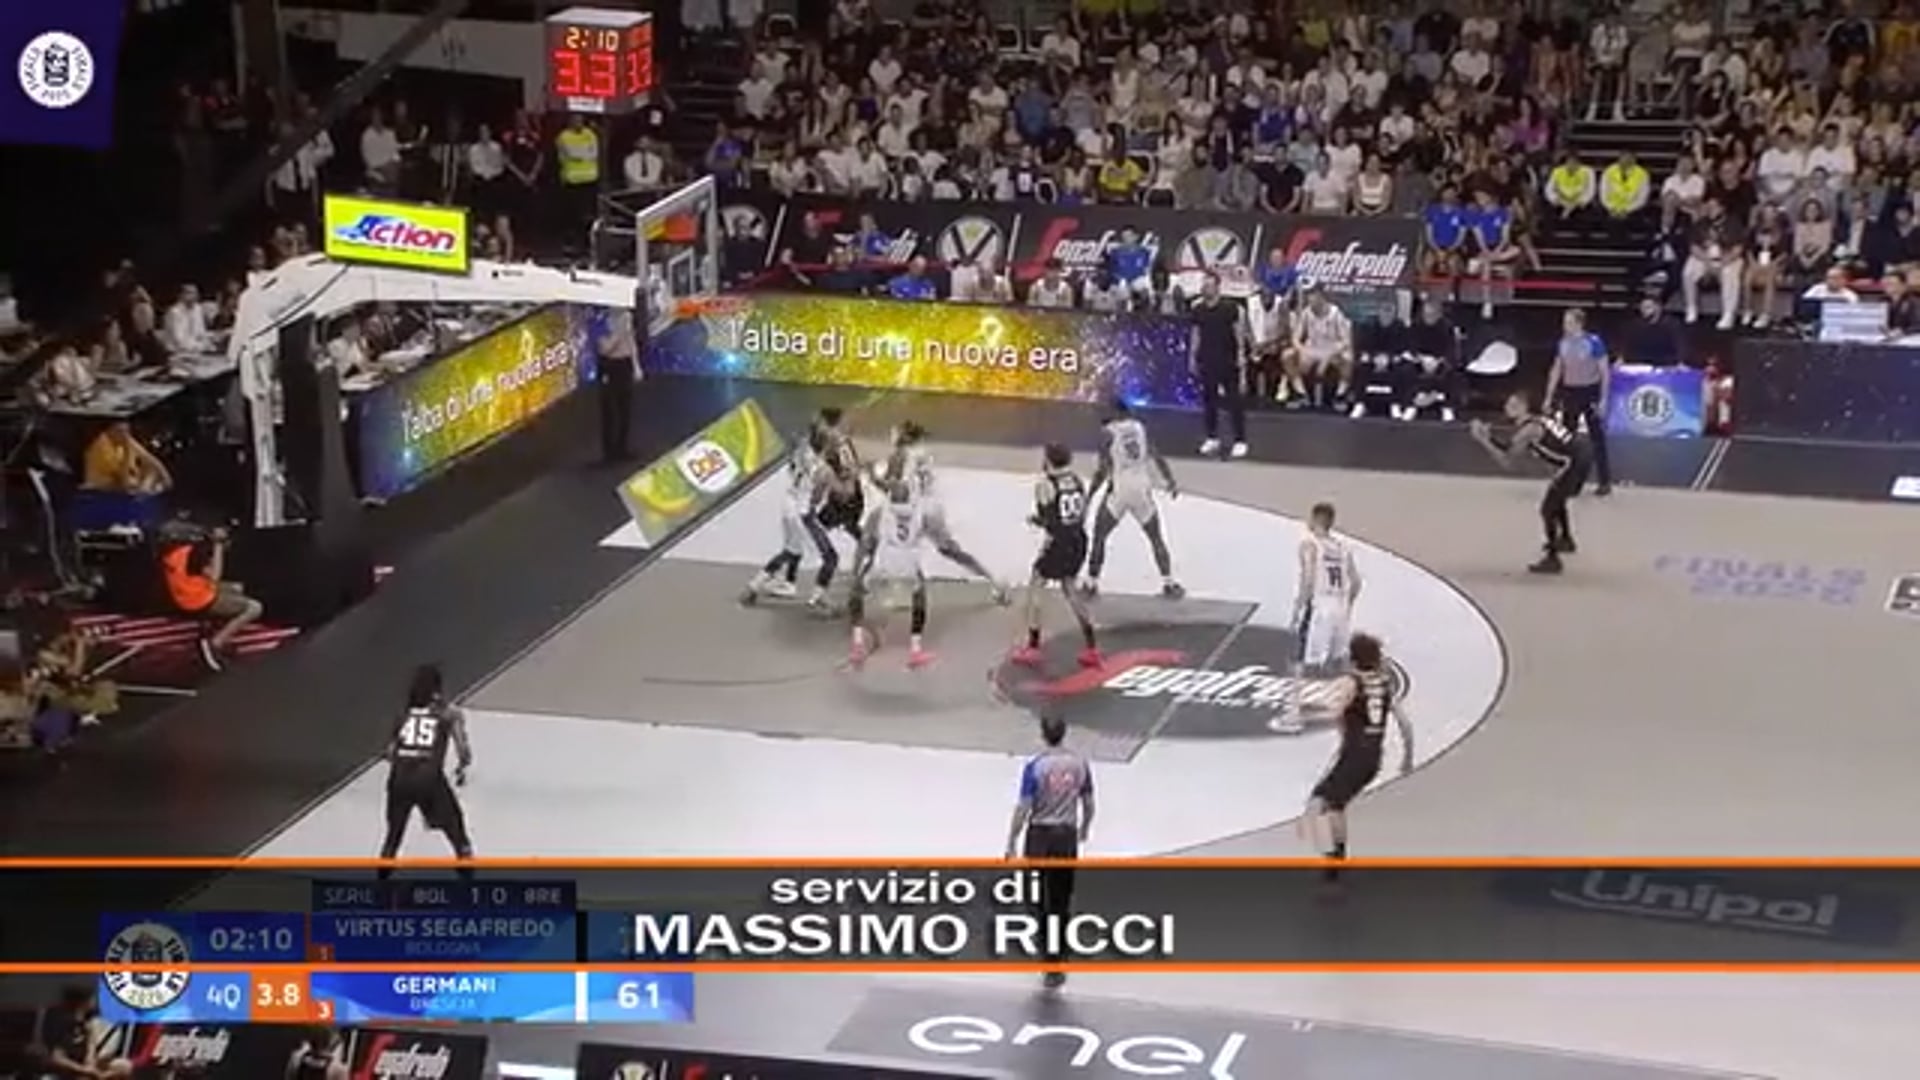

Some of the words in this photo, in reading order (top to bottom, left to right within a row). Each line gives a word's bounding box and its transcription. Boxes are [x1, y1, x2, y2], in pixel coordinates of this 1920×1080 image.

[566, 26, 619, 51] 2:10
[553, 50, 617, 96] 3.3
[817, 326, 845, 358] di
[924, 340, 1018, 367] nuova
[1028, 347, 1079, 372] era
[398, 716, 439, 747] 45
[1581, 867, 1838, 926] Unipol
[907, 1015, 1248, 1080] enel
